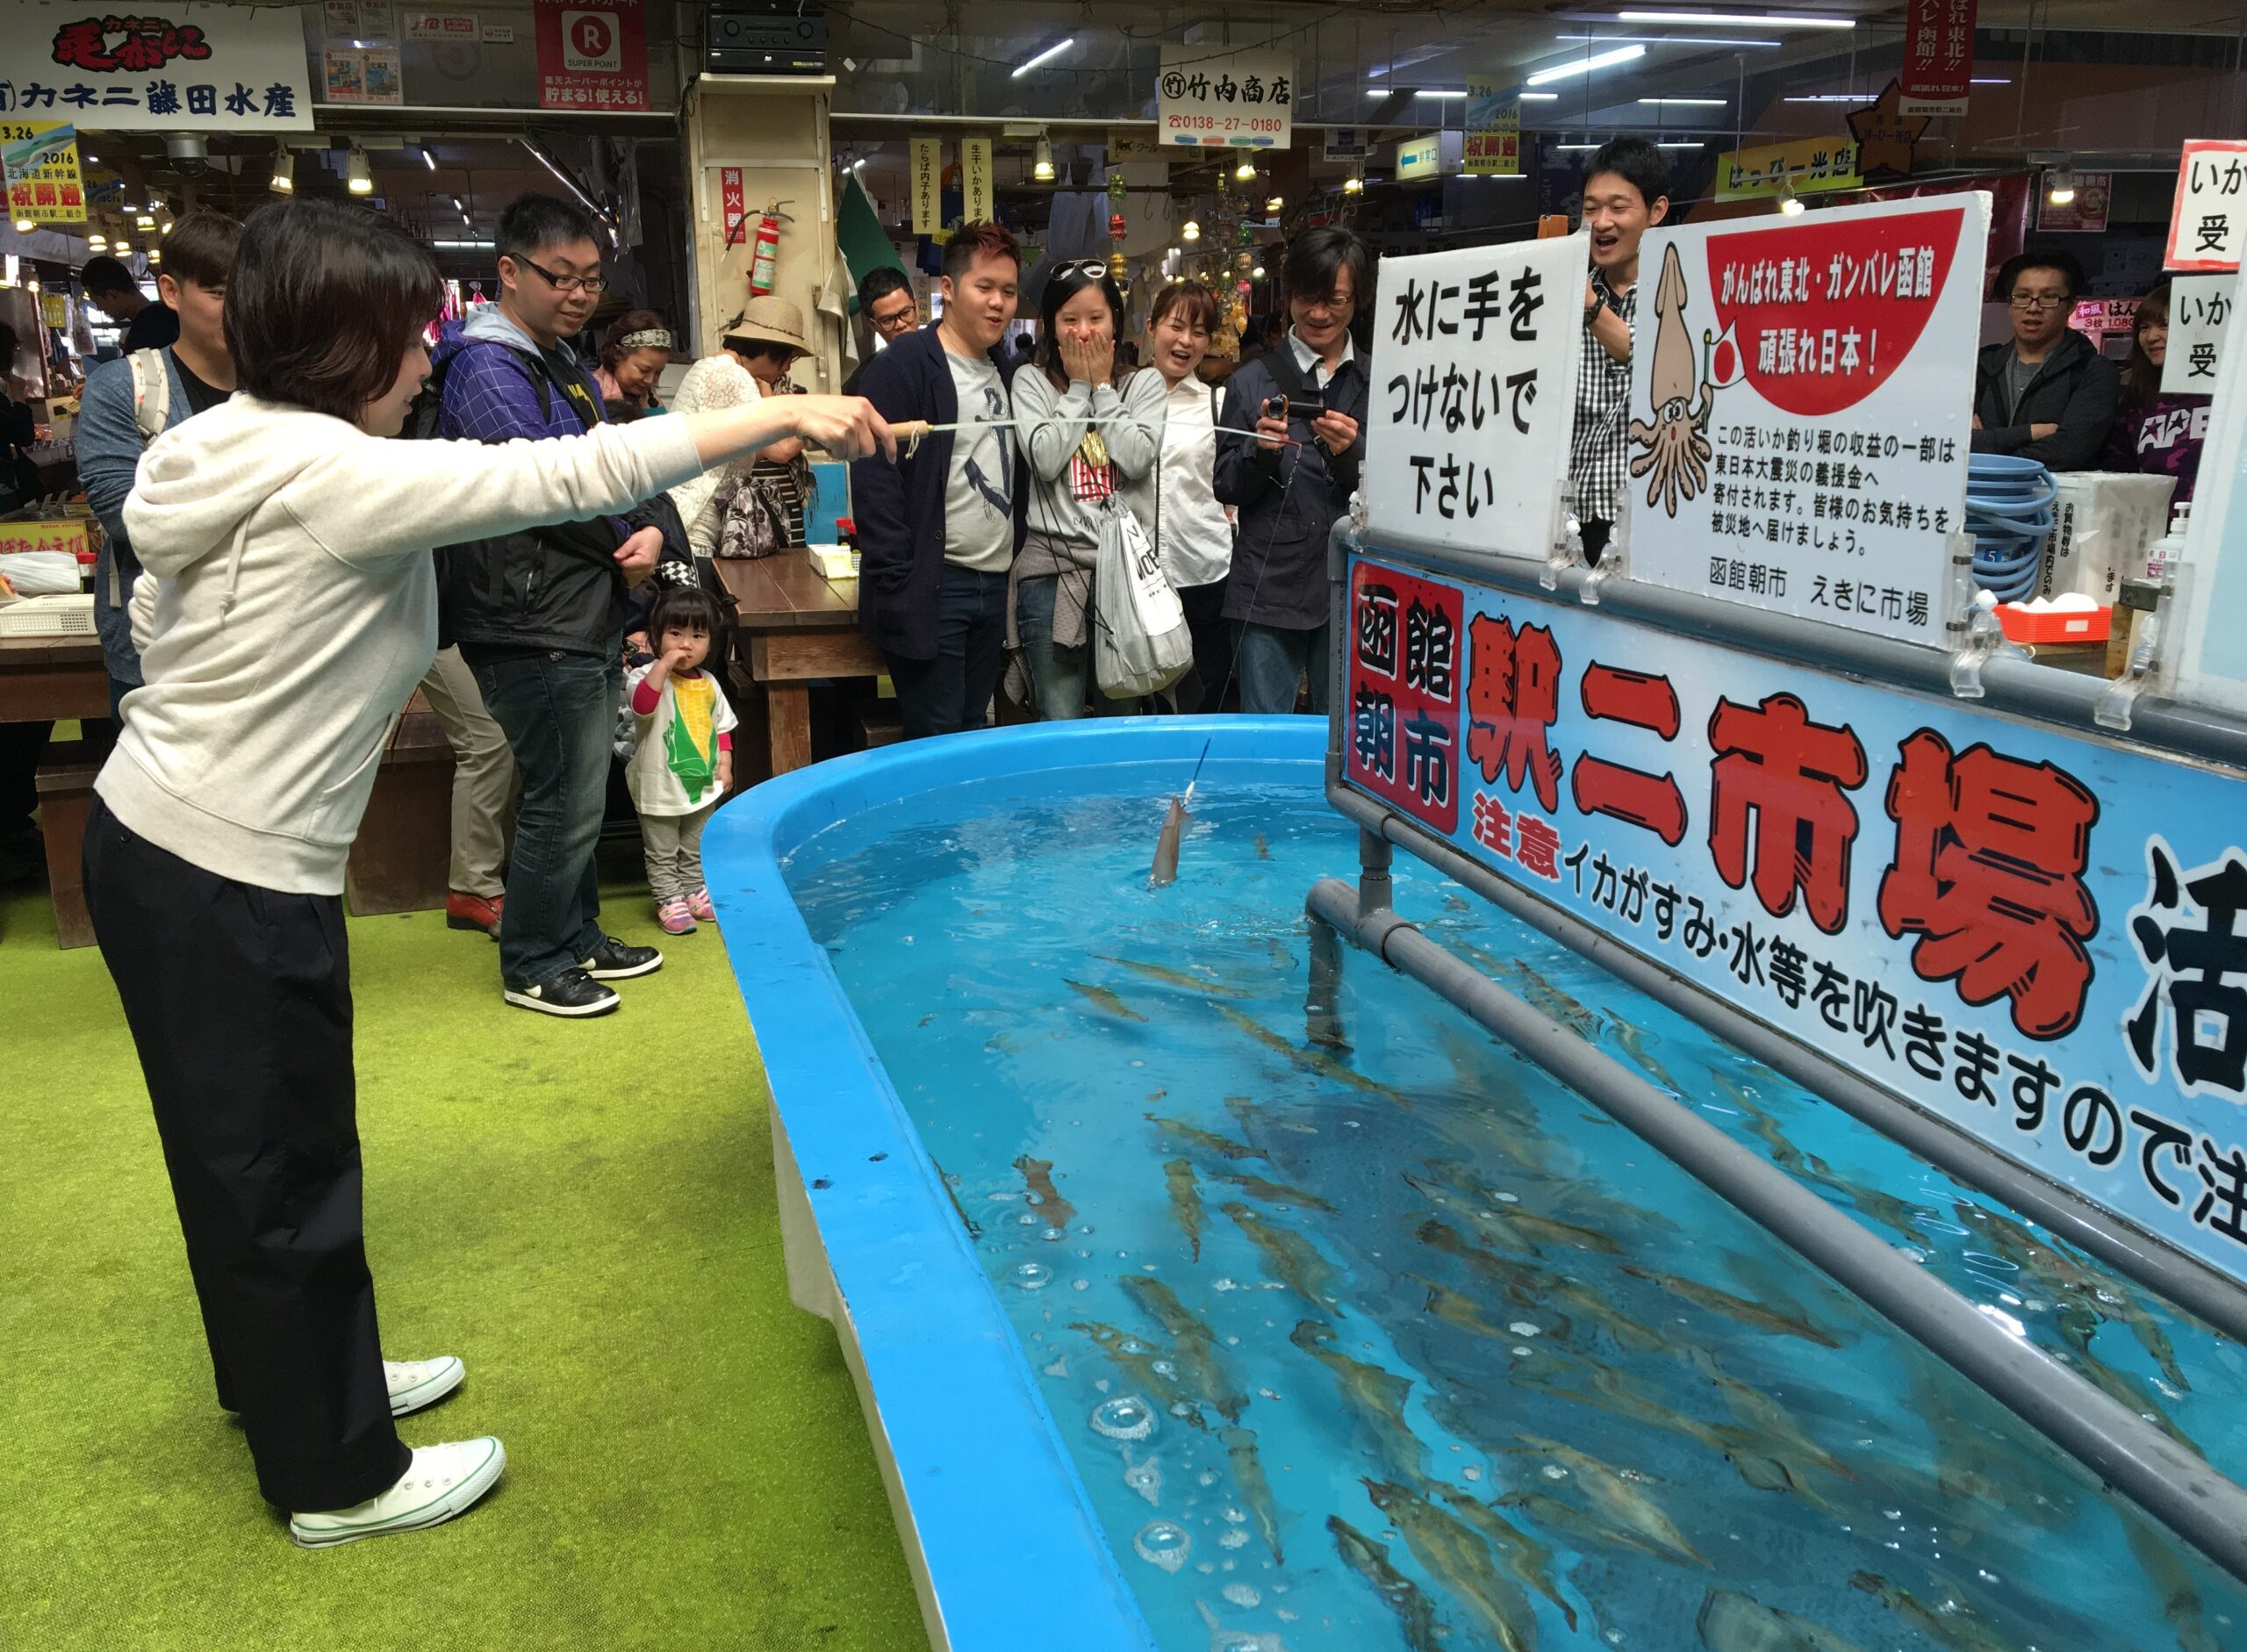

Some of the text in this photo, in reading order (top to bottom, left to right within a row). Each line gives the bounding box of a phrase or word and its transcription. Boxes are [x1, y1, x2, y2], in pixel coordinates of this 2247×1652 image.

[544, 75, 643, 88] 楽天スーパーポイントが
[568, 59, 618, 68] SUPER POINT
[1188, 72, 1291, 104] 竹内商店
[3, 126, 34, 140] 3.26
[1183, 114, 1281, 132] 0138-27-0180
[1496, 108, 1518, 119] 2016
[7, 169, 77, 180] 北海道新幹線
[42, 152, 74, 164] 2016
[11, 183, 82, 206] 祝開通
[725, 169, 743, 228] 消火器
[920, 143, 931, 228] たらば内子あります
[971, 144, 982, 221] 生干いかありま
[1720, 245, 1935, 305] がんばれ東北・ガンバレ函館
[1392, 266, 1544, 345] 水に手を
[2078, 303, 2103, 317] 和風
[2085, 318, 2103, 327] 3枚
[1757, 327, 1877, 376] 頑張れ日本!
[1388, 362, 1538, 435] つけないで
[1718, 425, 1956, 463] この活いか釣り堀の収益の一部は
[1410, 453, 1494, 519] 下さい
[1714, 454, 1878, 490] 東日本大震災の義援金へ
[1711, 512, 1867, 557] 被災地へ届けましょう。
[1709, 556, 1929, 627] 函館朝市 えきに市場
[1356, 584, 1456, 702] 函館
[1354, 681, 1453, 808] 朝市
[1467, 611, 2100, 1041] 駅二市場
[1472, 792, 1561, 881] 注意
